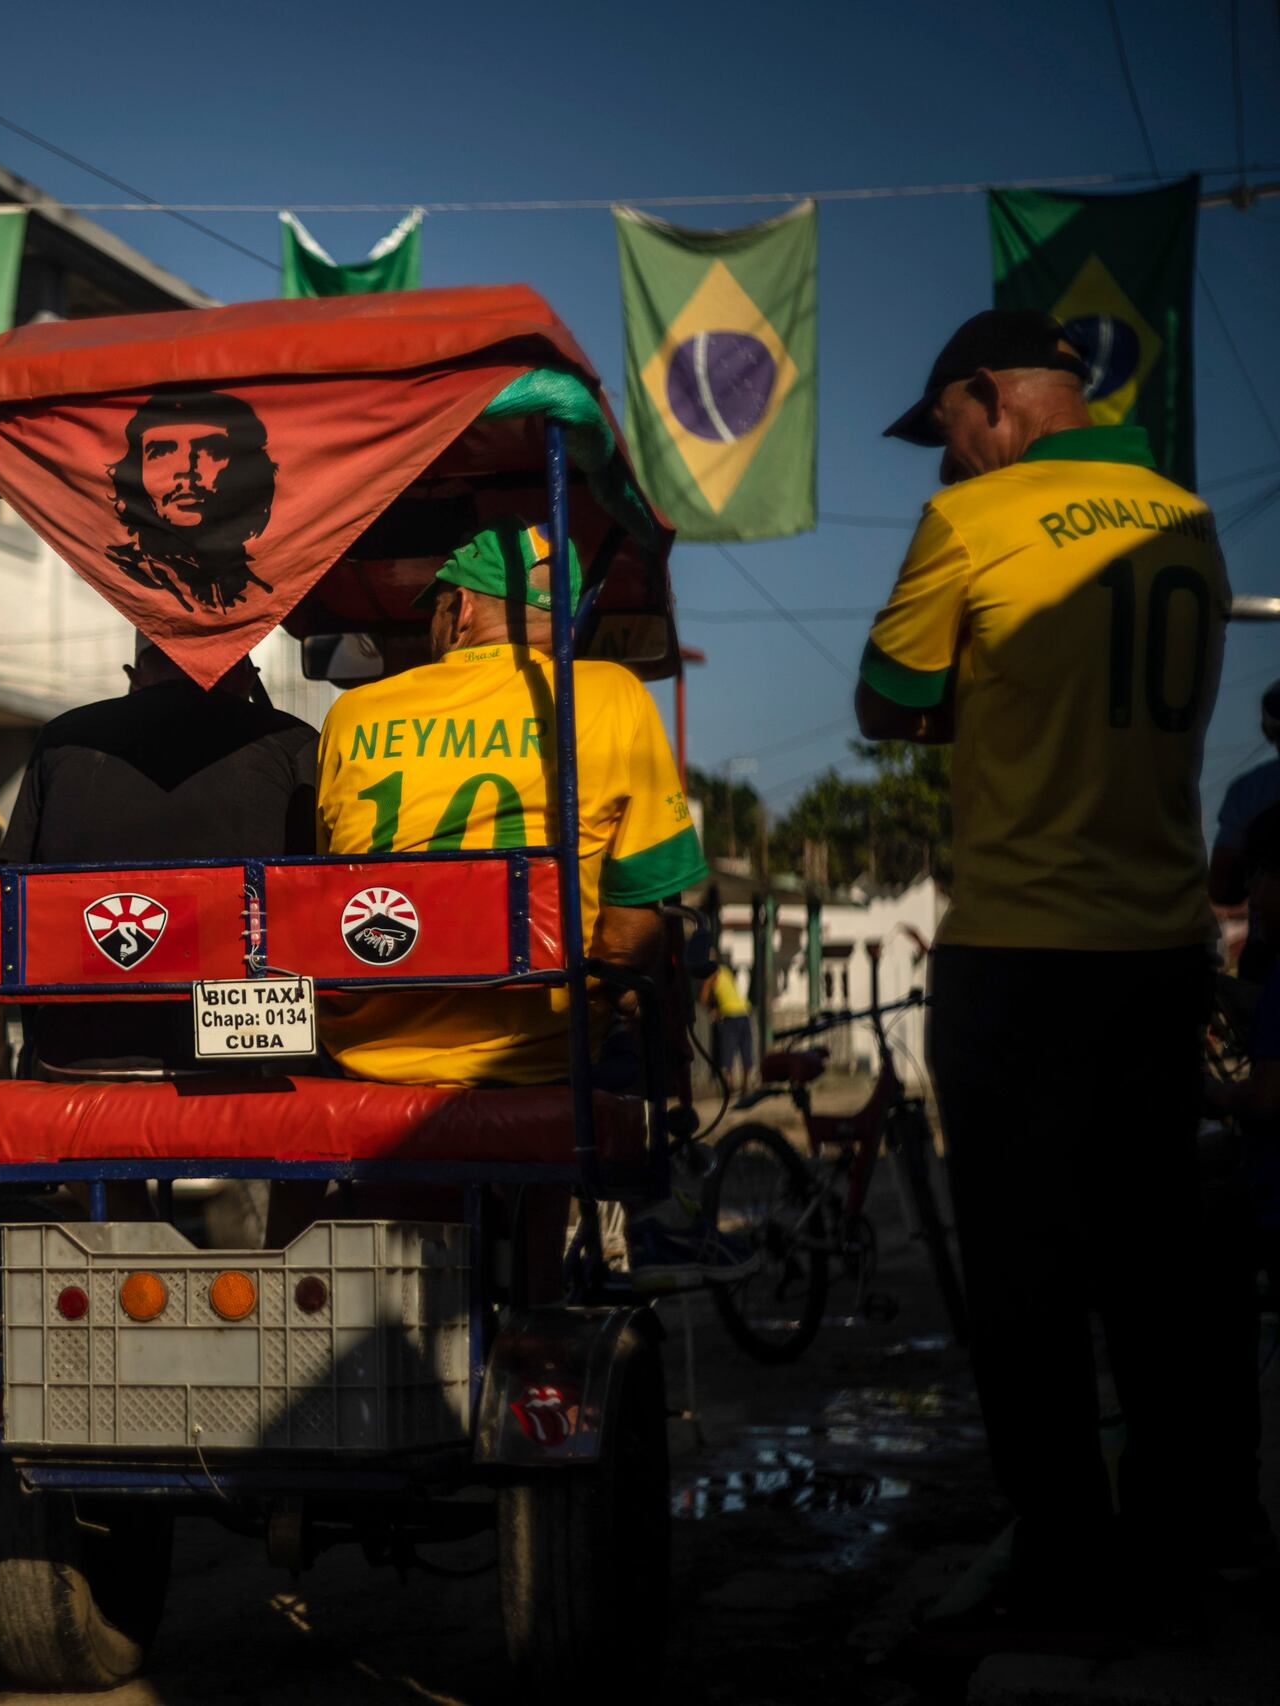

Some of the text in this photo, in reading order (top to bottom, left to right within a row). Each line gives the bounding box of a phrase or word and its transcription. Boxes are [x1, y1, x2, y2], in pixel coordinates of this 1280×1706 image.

[1039, 498, 1214, 549] RONALDINH
[1098, 557, 1207, 732] 10
[464, 647, 501, 665] Brasil
[350, 717, 549, 761] NEYMAR
[207, 987, 304, 1005] BICI TAXI
[201, 1008, 307, 1030] Chapa: 0134
[226, 1034, 284, 1049] CUBA
